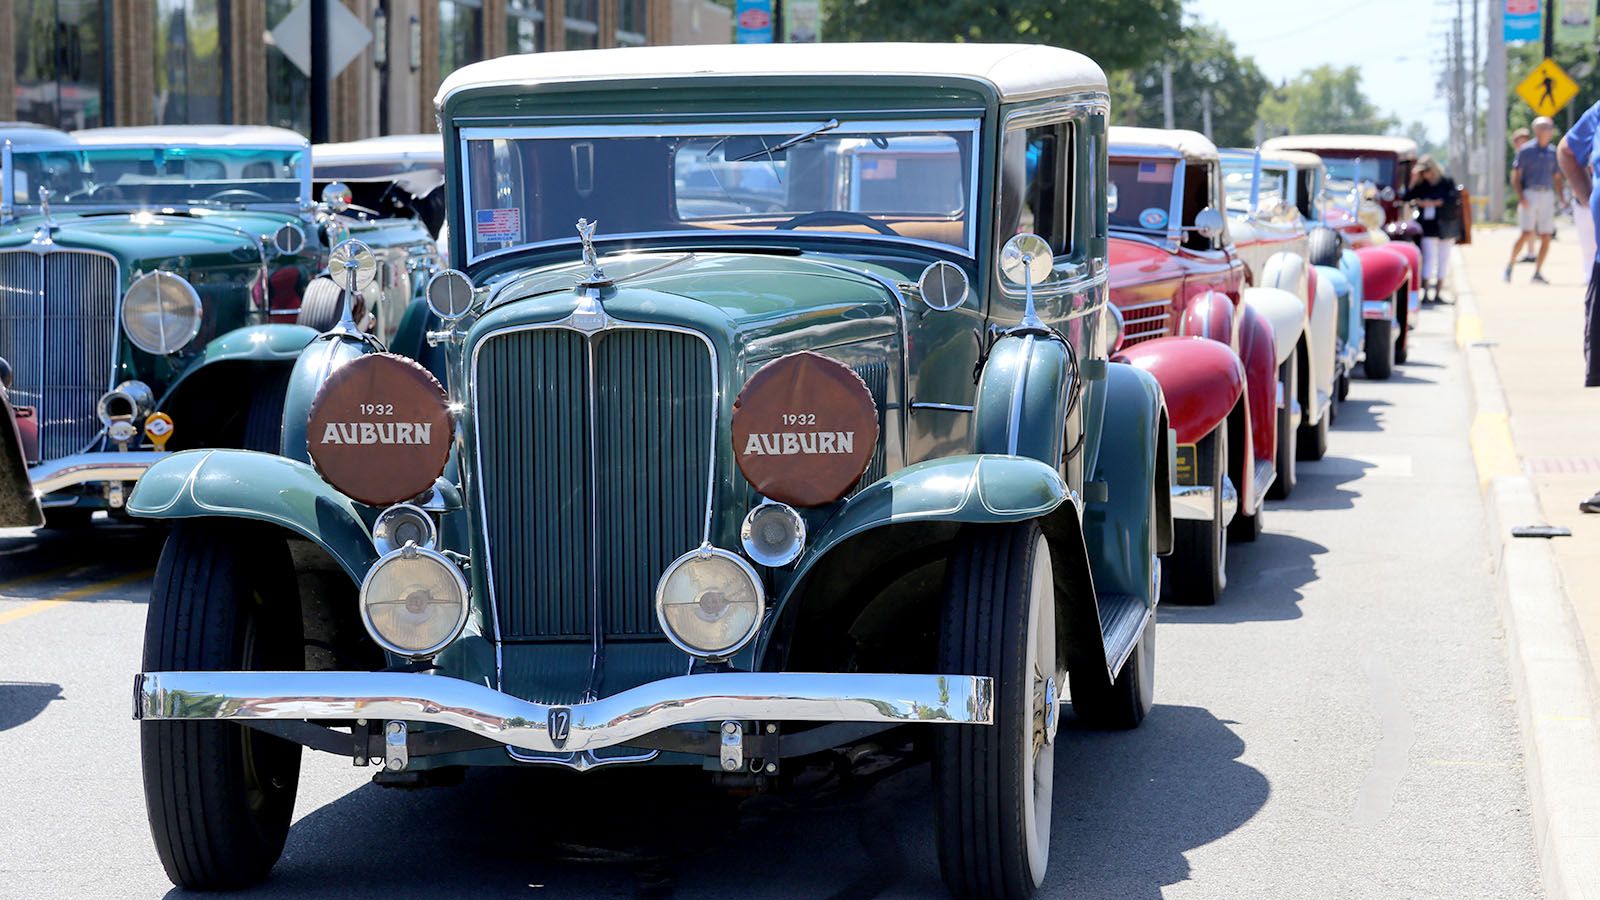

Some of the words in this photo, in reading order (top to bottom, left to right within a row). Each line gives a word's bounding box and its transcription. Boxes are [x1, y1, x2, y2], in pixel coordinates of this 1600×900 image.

[360, 404, 394, 415] 1932
[782, 413, 816, 425] 1932
[320, 422, 433, 445] AUBURN
[743, 431, 855, 455] AUBURN
[551, 711, 568, 740] 12
